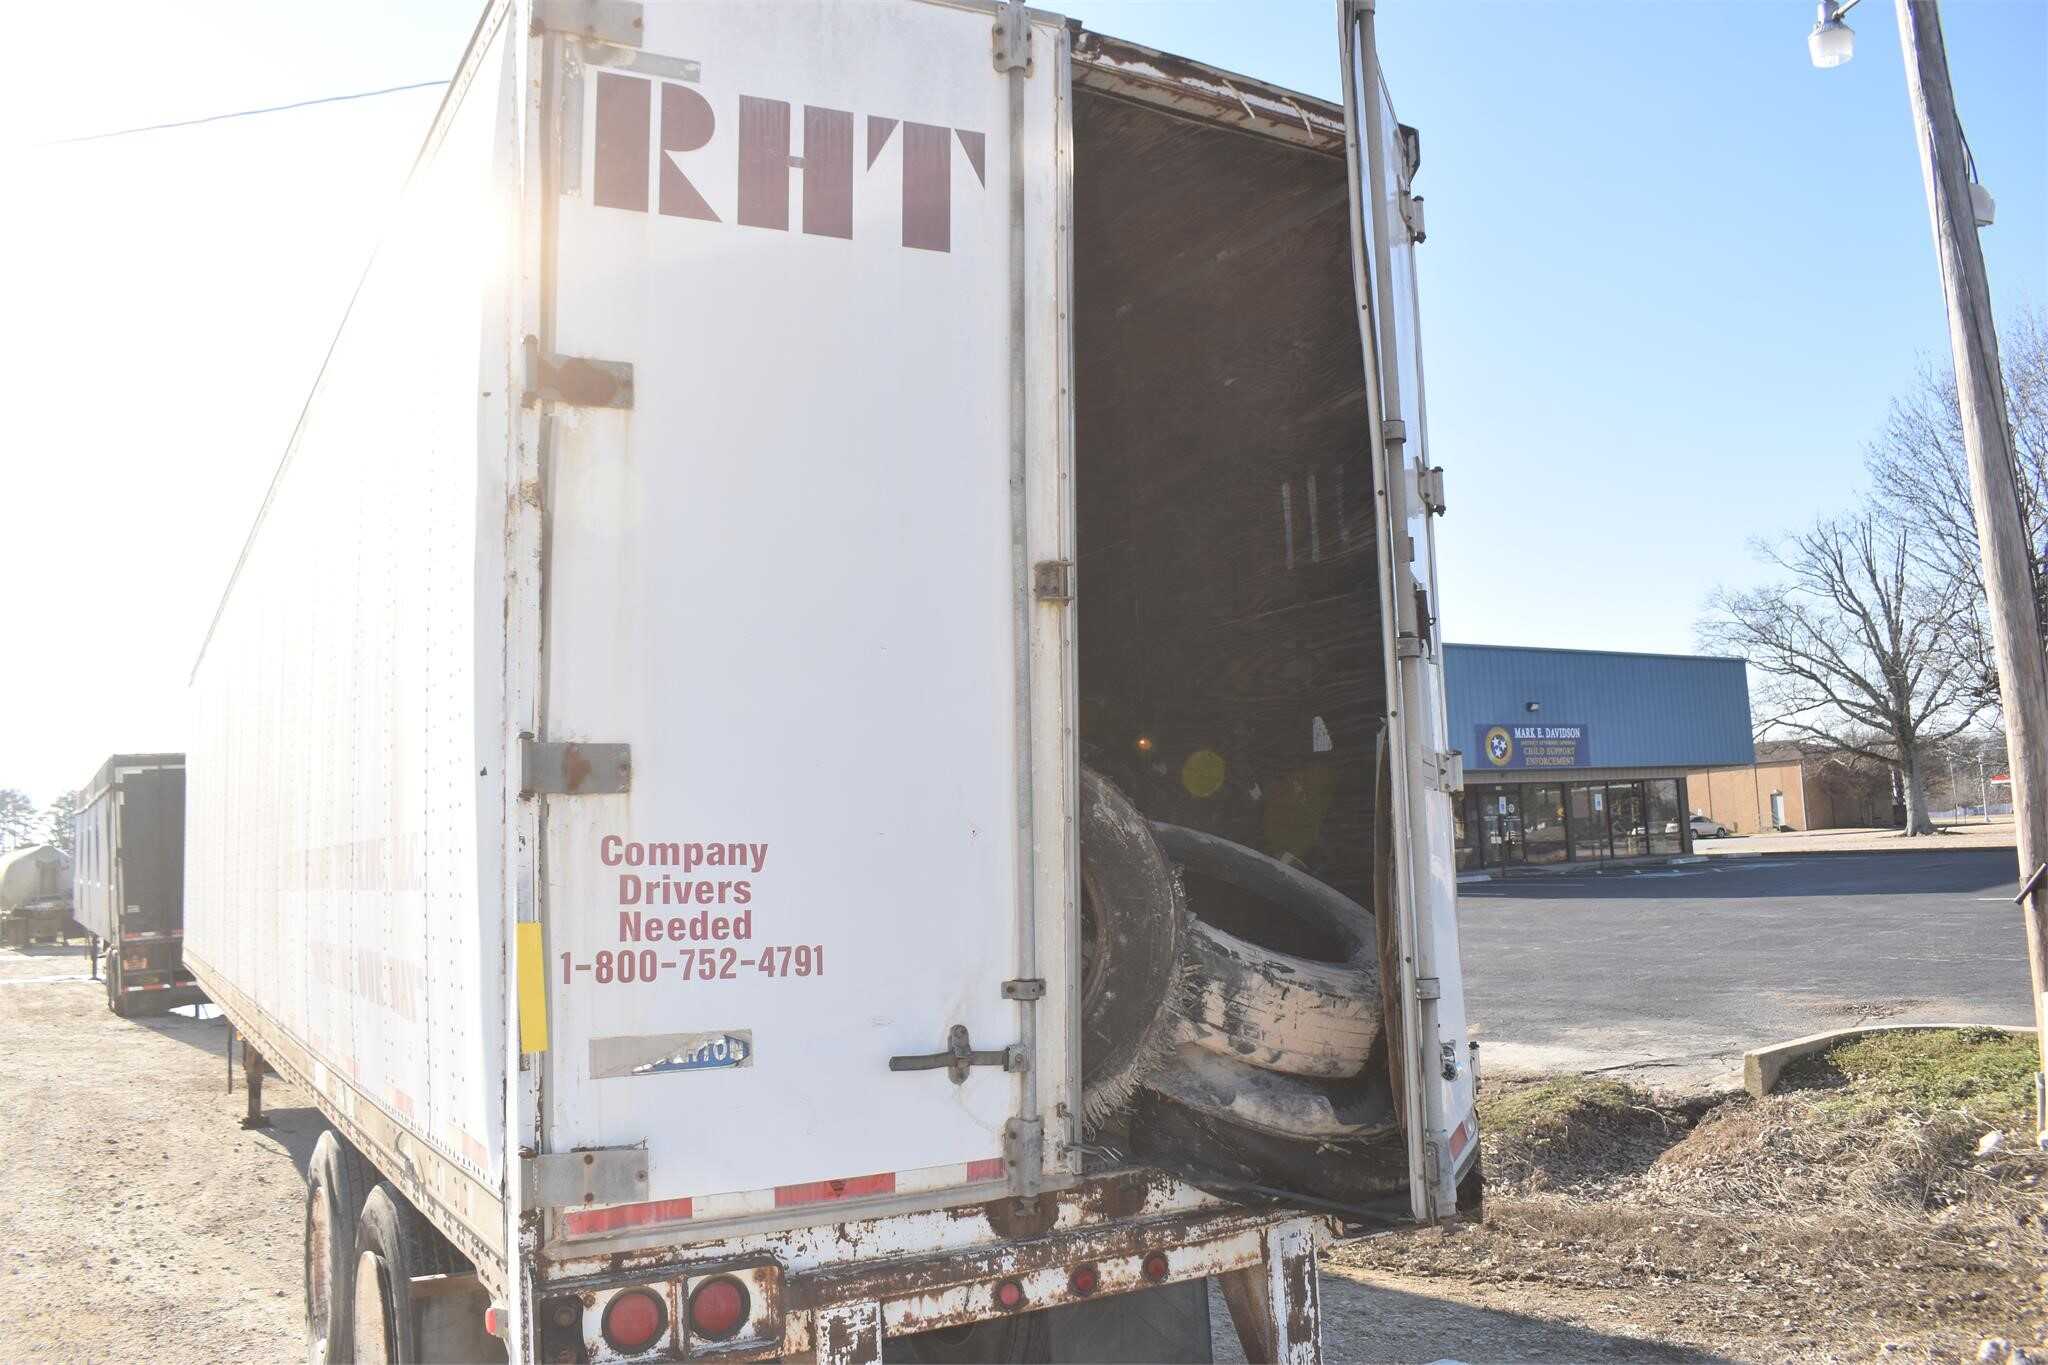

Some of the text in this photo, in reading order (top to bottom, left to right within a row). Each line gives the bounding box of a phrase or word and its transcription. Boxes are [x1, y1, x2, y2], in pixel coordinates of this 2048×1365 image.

[594, 71, 985, 253] RHT
[1514, 727, 1581, 738] MARK E. DAVIDSON
[601, 835, 768, 873] Company
[619, 874, 752, 905] Drivers
[619, 910, 752, 942] Needed
[560, 945, 823, 985] 1-800-752-4791
